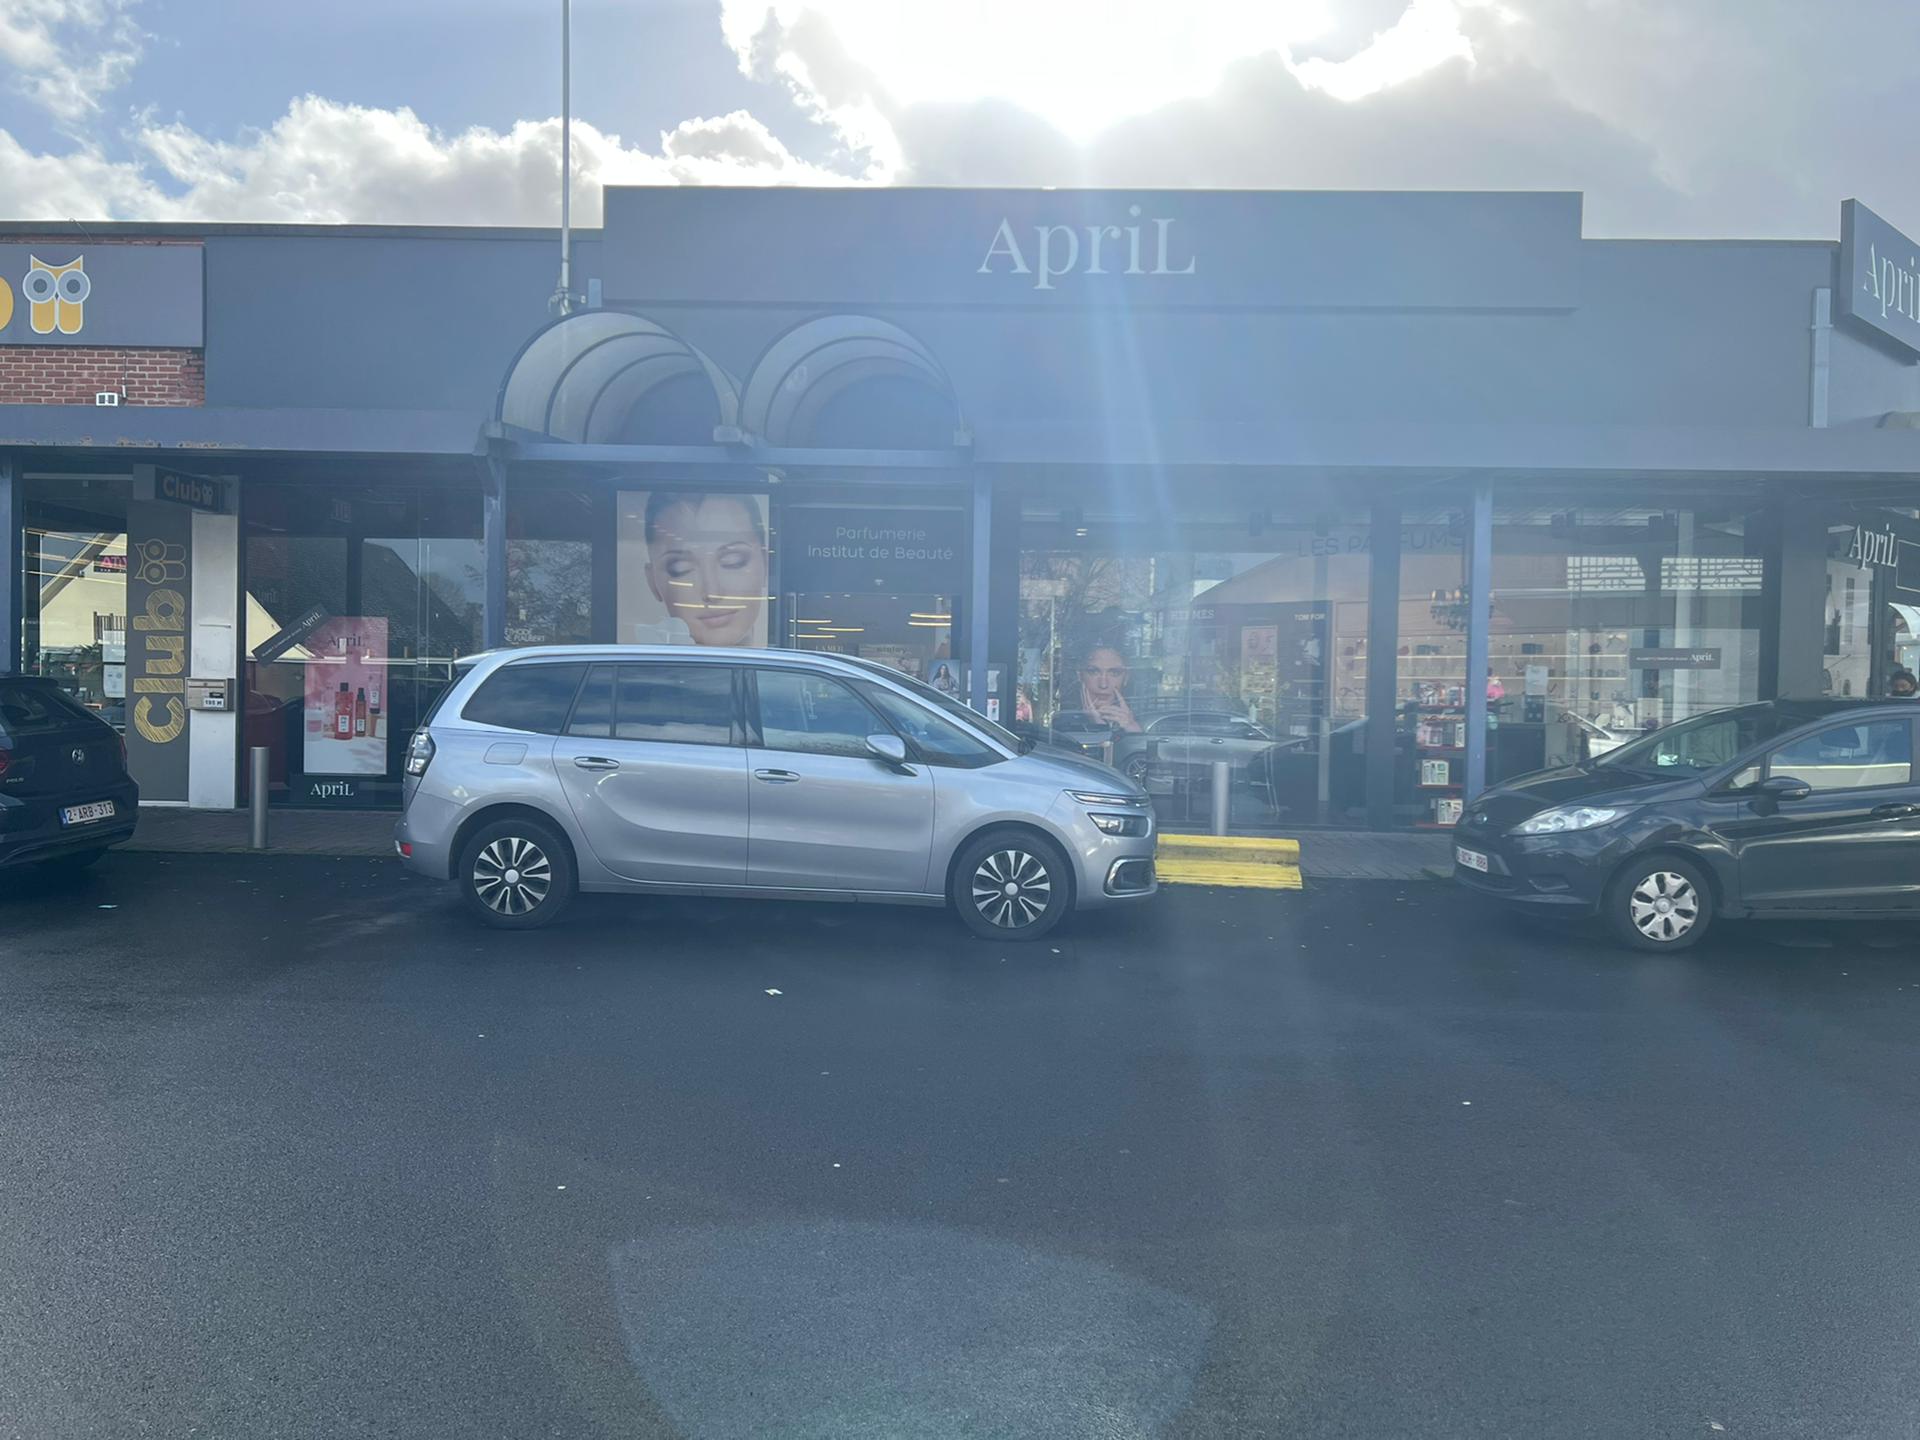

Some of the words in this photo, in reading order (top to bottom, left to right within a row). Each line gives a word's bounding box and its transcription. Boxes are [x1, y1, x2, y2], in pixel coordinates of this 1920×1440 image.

[977, 205, 1196, 290] ApriL
[162, 475, 201, 502] Club
[835, 526, 927, 541] Parfumerie
[808, 544, 865, 559] Institut
[869, 545, 890, 559] de
[894, 546, 953, 561] Beauté
[1297, 537, 1340, 558] LES
[132, 588, 186, 744] Club
[310, 781, 354, 799] ApriL
